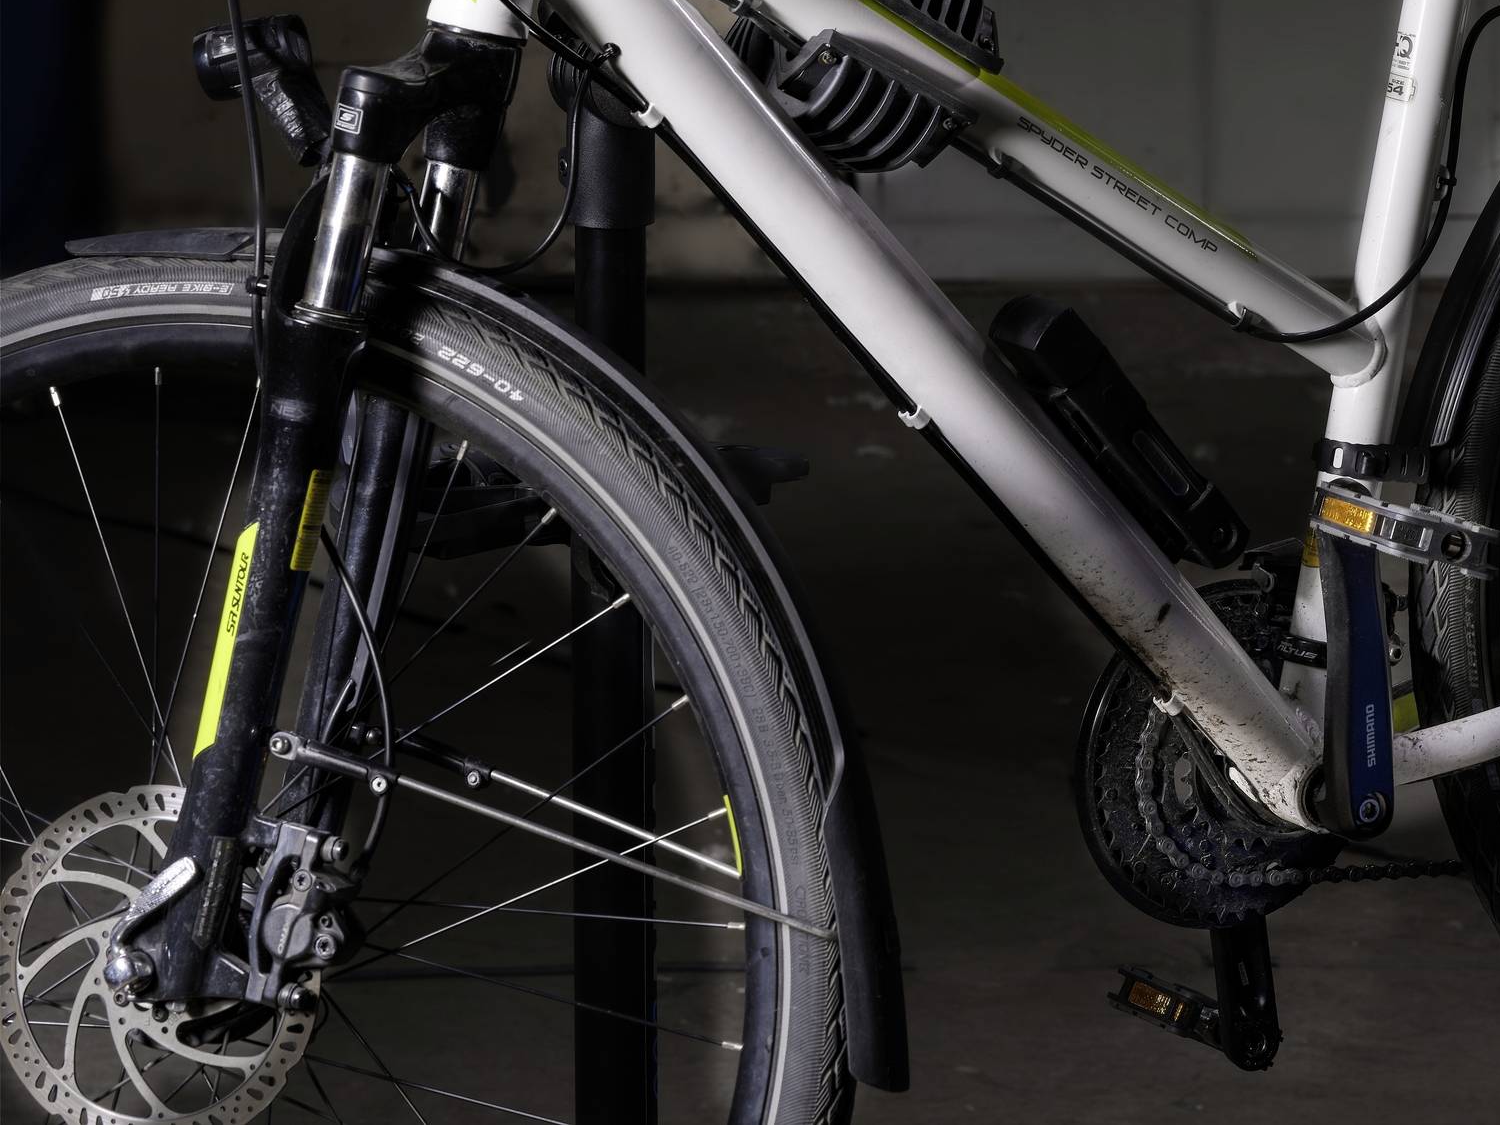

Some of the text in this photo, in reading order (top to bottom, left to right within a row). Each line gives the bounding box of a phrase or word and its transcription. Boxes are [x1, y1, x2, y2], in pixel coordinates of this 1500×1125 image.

[1016, 116, 1218, 253] SPYDER STREET COMP
[134, 283, 177, 294] READY
[182, 282, 230, 293] E-BIKE
[436, 345, 525, 402] 40-622
[226, 551, 249, 637] SR SUNTOUR
[1365, 703, 1377, 768] SHIMANO
